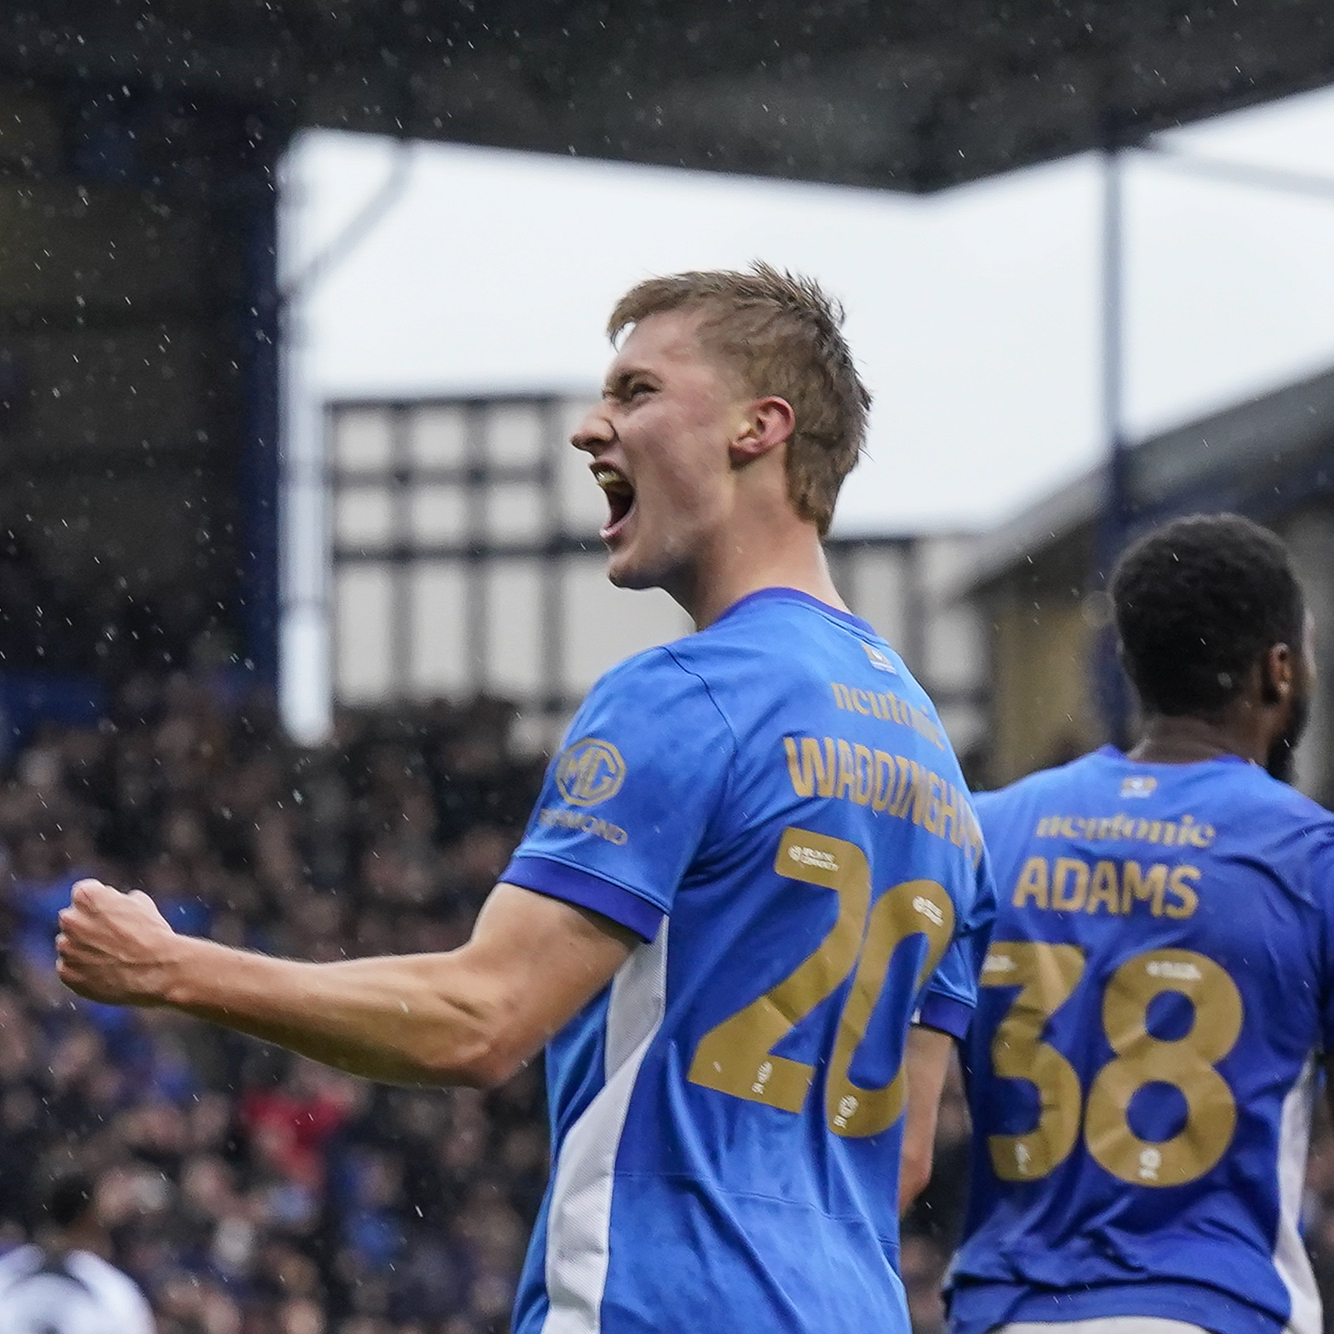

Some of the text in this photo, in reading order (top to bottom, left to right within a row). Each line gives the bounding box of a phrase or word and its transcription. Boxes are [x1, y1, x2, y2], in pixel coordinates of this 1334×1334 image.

[831, 682, 945, 750] neuto
[1036, 814, 1216, 848] neutonic
[1012, 856, 1202, 919] ADAMS
[688, 826, 955, 1138] 20
[979, 940, 1243, 1188] 38
